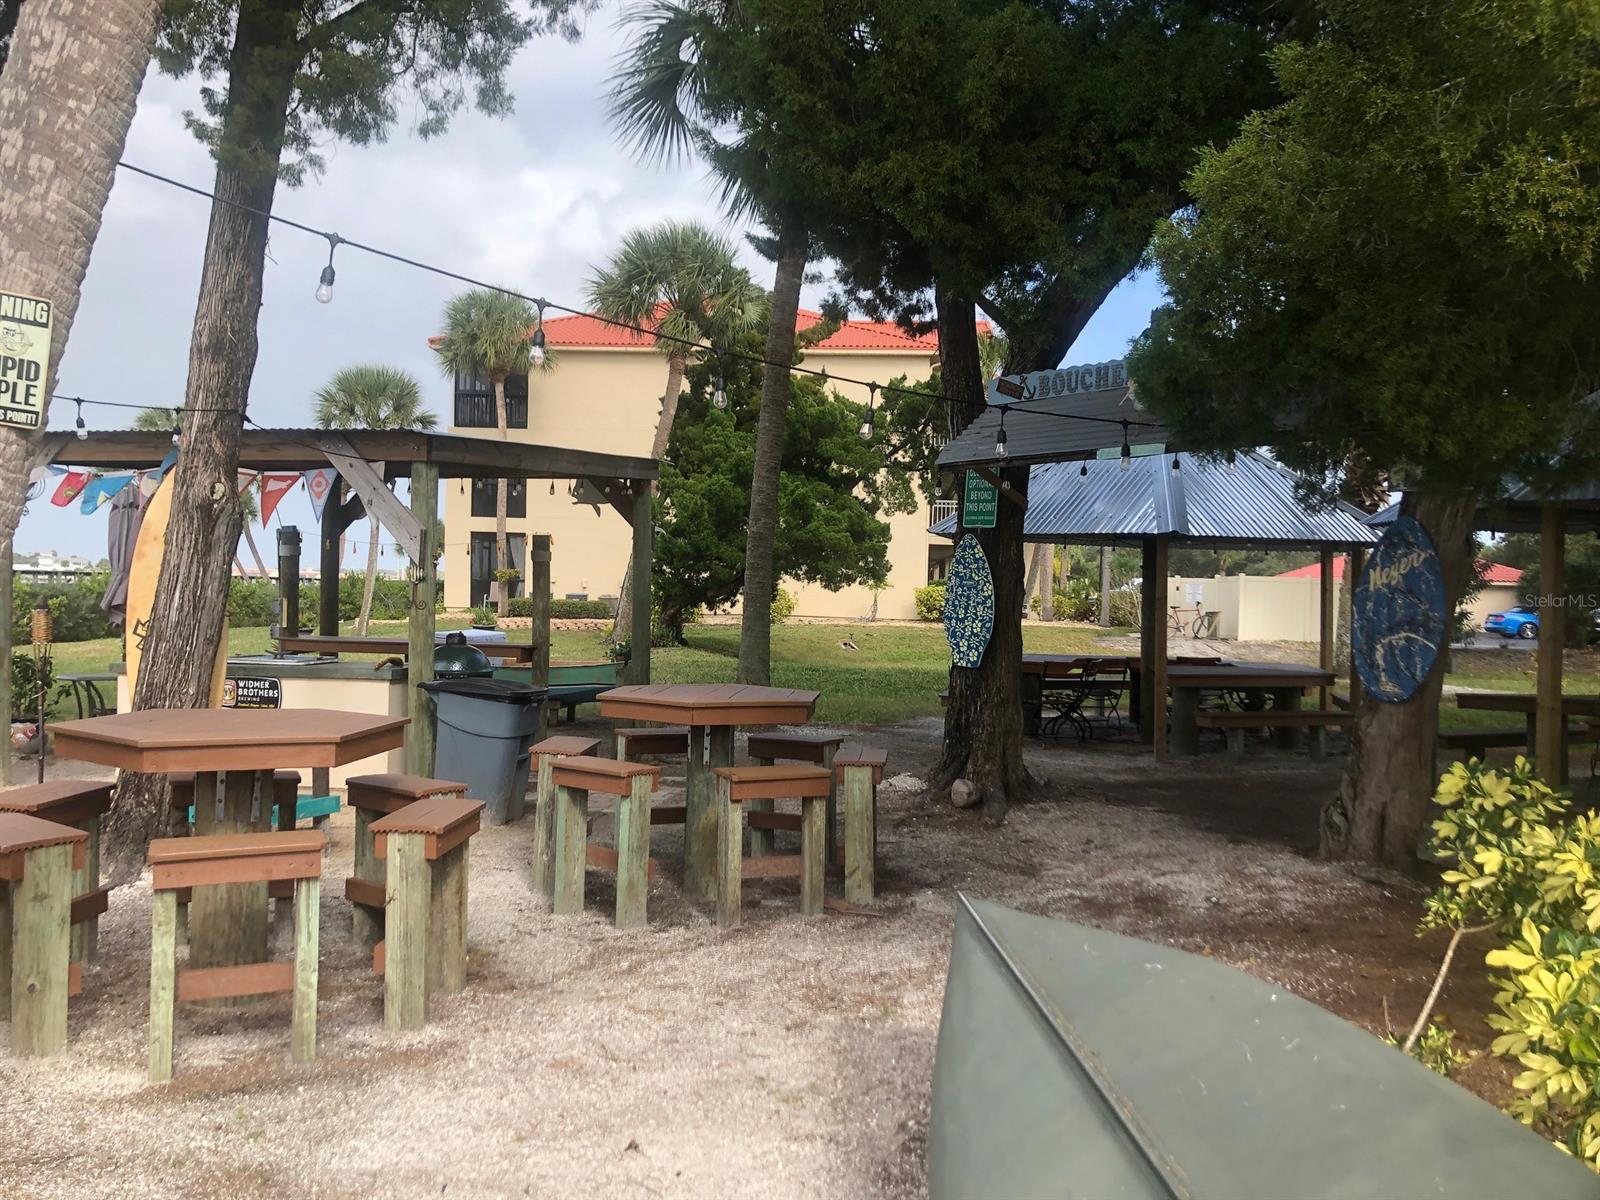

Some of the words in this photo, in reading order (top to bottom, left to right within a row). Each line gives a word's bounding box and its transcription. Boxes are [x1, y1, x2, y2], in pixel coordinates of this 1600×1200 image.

[0, 355, 41, 382] PID
[1038, 363, 1128, 397] BOUCHE
[970, 490, 993, 500] BEYOND
[966, 502, 978, 512] THIS
[979, 502, 996, 512] POINT
[237, 680, 270, 689] WIDMER
[237, 688, 279, 698] BROTHERS
